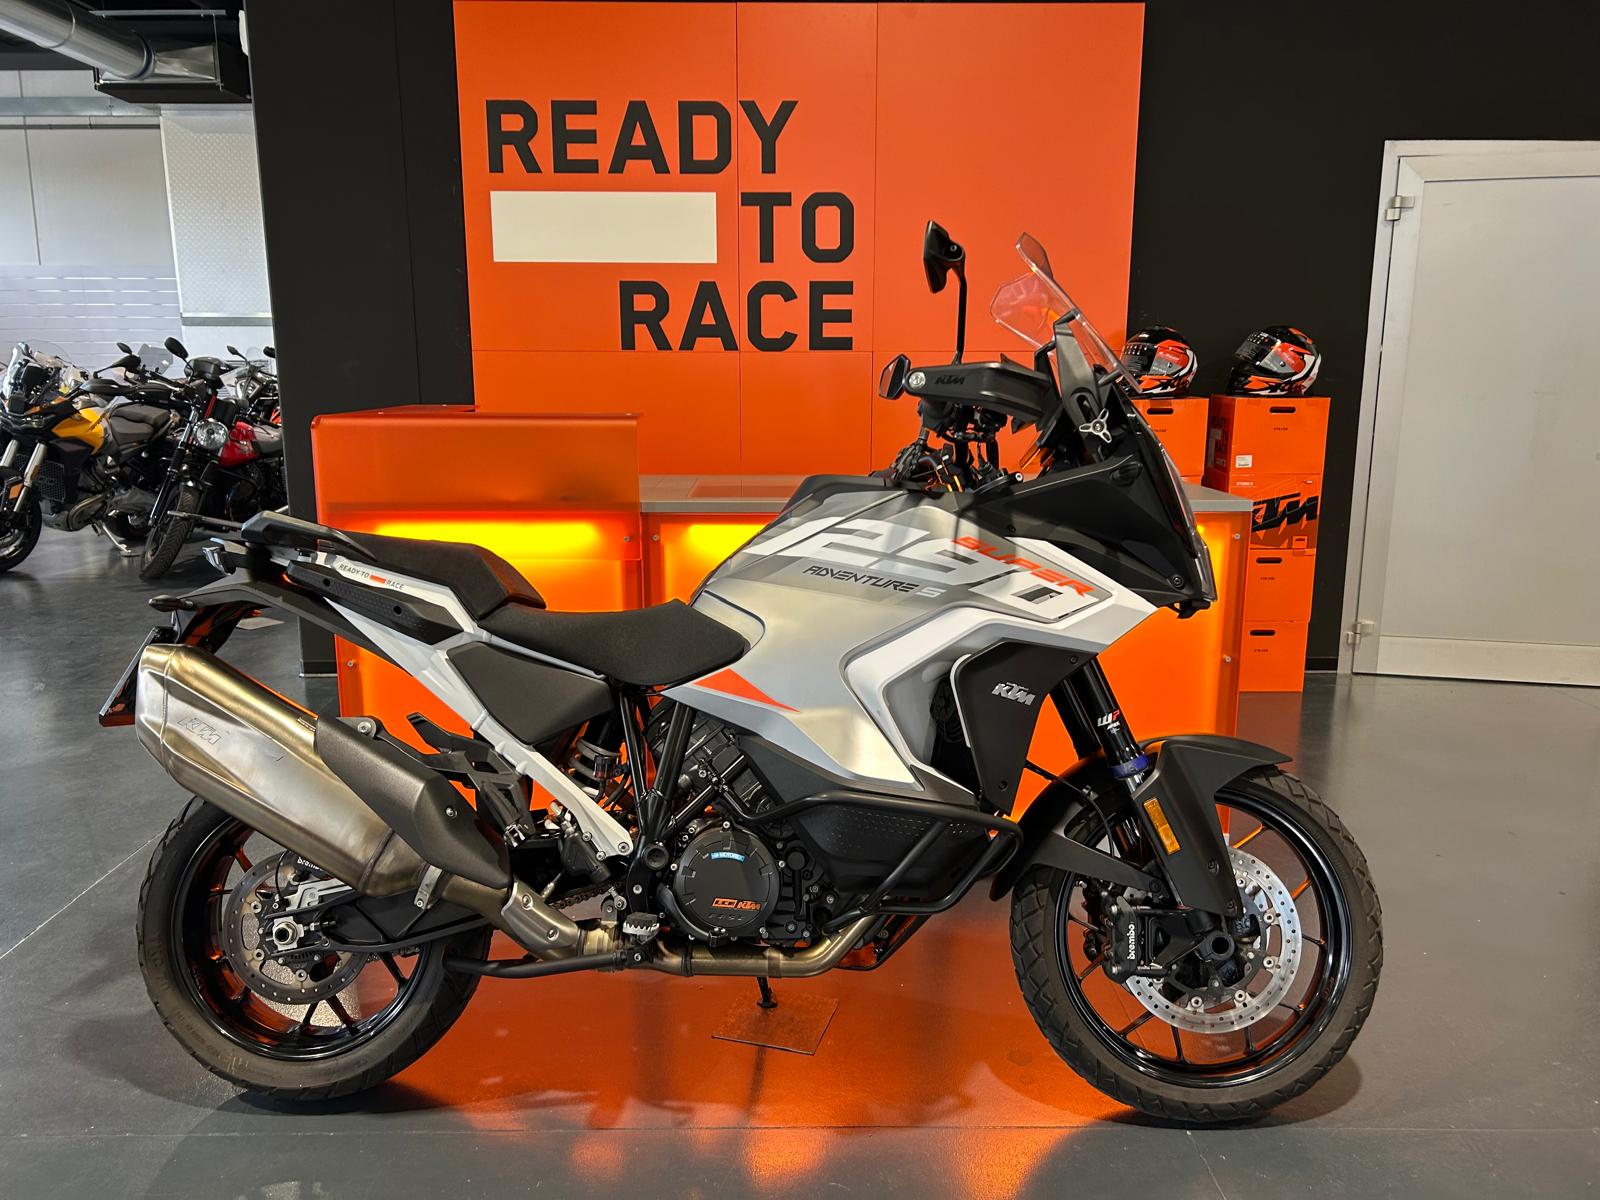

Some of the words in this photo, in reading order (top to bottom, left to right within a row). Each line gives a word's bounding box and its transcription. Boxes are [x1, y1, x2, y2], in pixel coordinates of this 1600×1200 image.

[486, 100, 797, 174] READY
[741, 192, 854, 263] TO
[620, 281, 853, 352] RACE
[934, 374, 966, 385] KTM
[339, 563, 360, 575] READY
[360, 571, 369, 579] TO
[386, 579, 404, 589] RACE
[802, 564, 920, 593] ADVENTURE
[916, 587, 947, 599] S
[952, 536, 1095, 597] SUPER
[991, 682, 1036, 706] KTM
[177, 717, 222, 745] KTM
[737, 901, 761, 910] KTM
[1126, 923, 1136, 960] brembo
